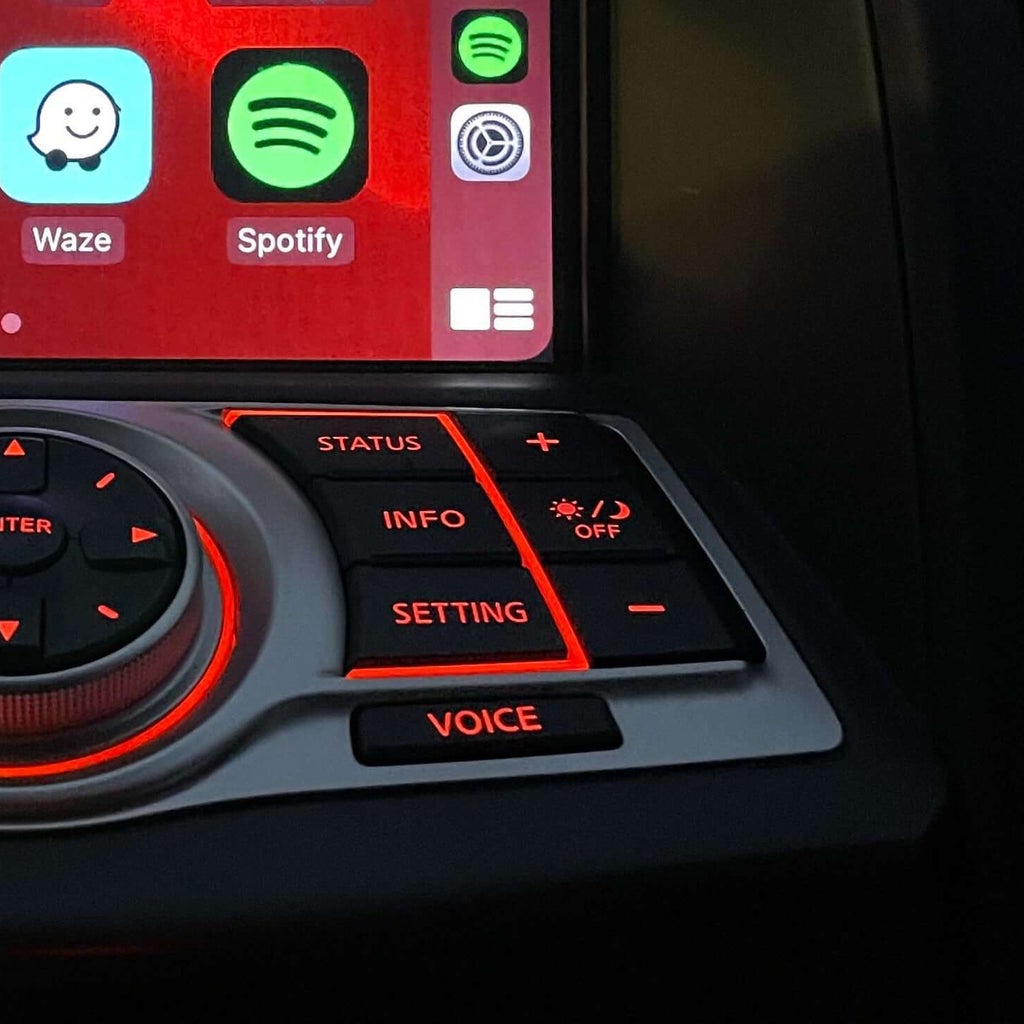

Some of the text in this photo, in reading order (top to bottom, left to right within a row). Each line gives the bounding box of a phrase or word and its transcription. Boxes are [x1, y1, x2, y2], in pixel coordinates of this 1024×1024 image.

[32, 226, 112, 253] Waze
[237, 226, 343, 259] Spotify
[317, 435, 422, 452] STATUS
[382, 509, 466, 530] INFO
[574, 523, 622, 540] OFF
[392, 601, 529, 625] SETTING
[426, 705, 543, 737] VOICE
